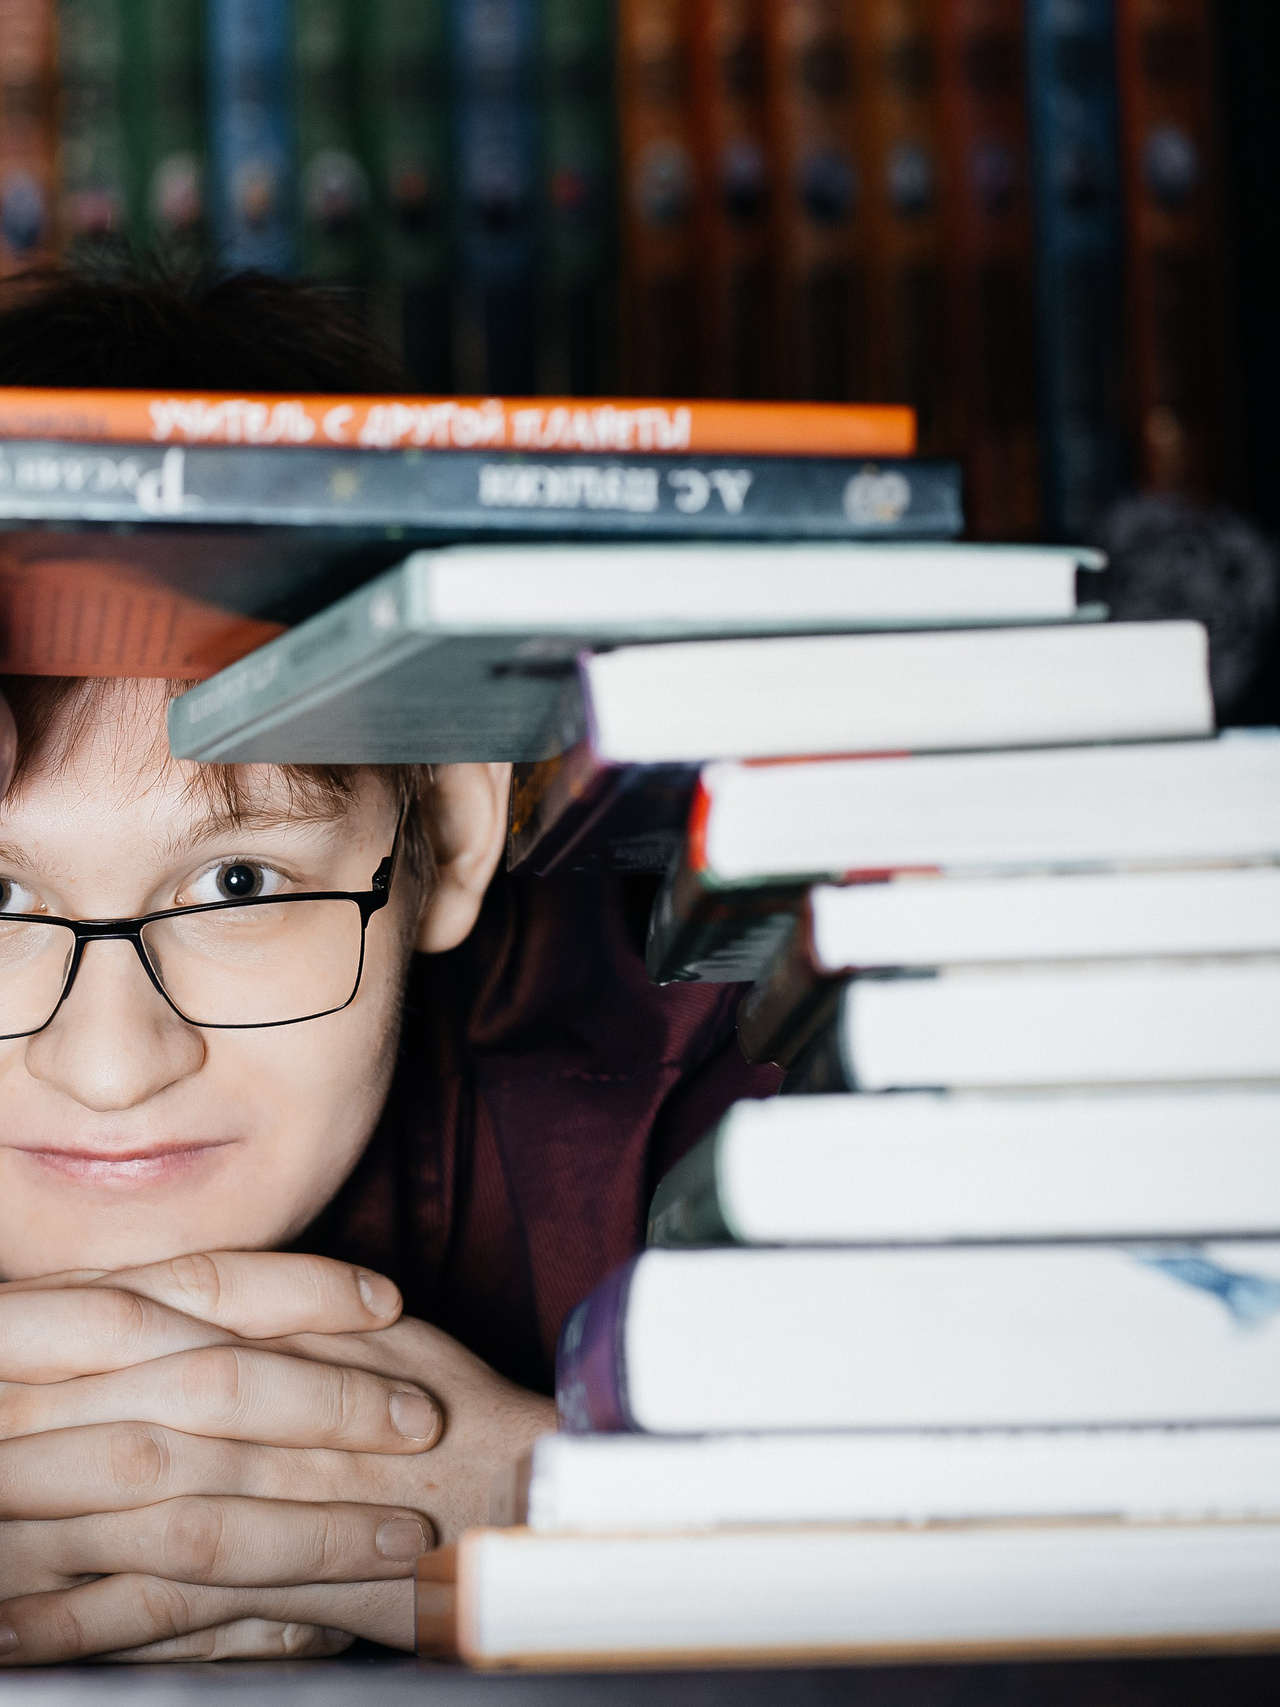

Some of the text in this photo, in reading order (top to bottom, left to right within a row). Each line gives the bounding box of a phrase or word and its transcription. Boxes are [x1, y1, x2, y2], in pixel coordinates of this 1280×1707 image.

[149, 400, 316, 443] УЧИТЕЛЬ
[323, 403, 355, 442] С
[358, 398, 505, 450] ДРУГОЙ
